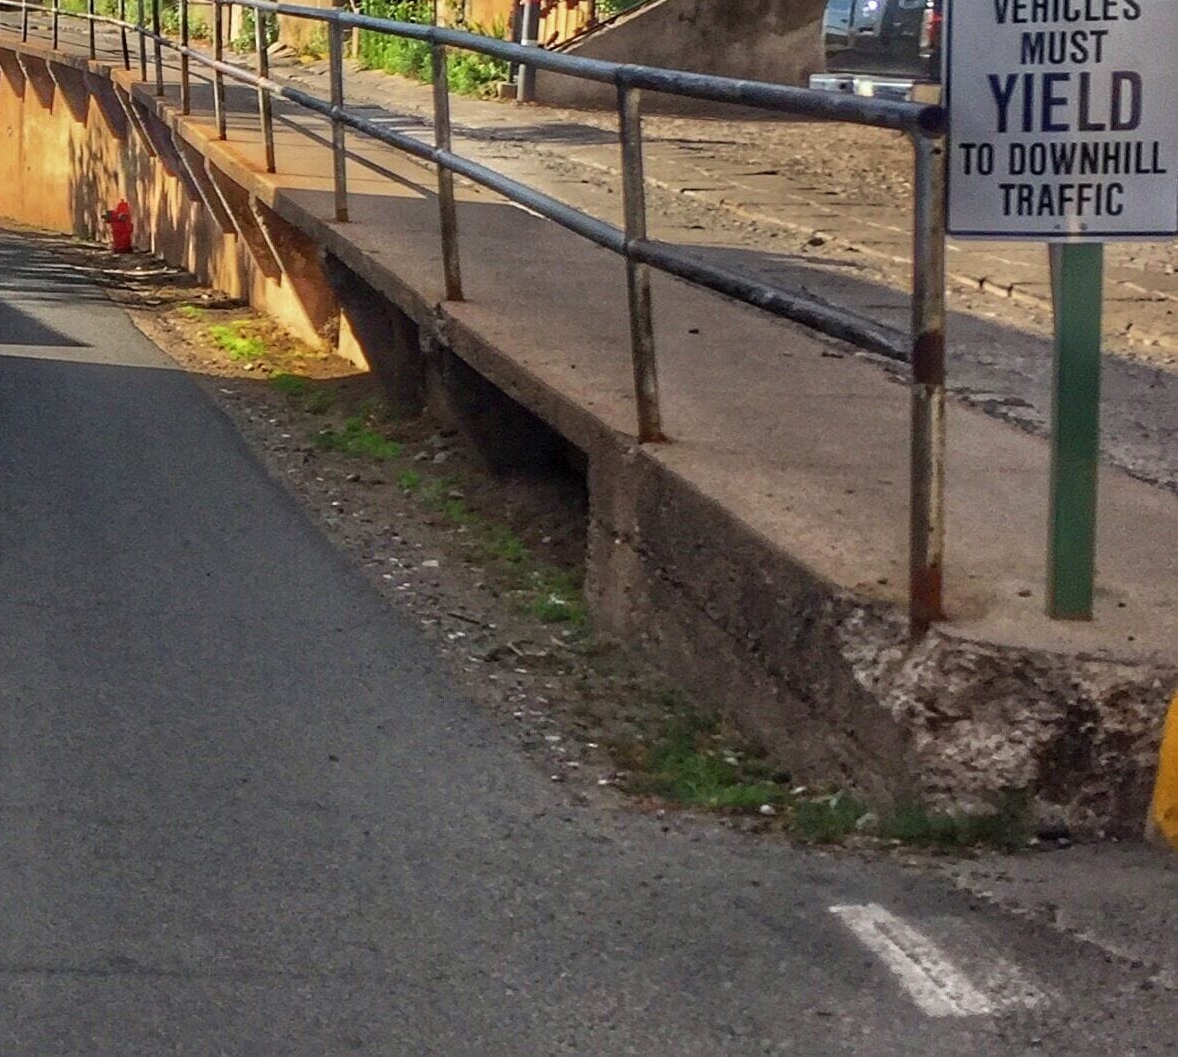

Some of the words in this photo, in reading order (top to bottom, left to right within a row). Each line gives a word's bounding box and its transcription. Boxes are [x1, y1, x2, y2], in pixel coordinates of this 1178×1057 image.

[1020, 29, 1109, 65] MUST
[986, 70, 1143, 133] YIELD
[959, 142, 994, 176] TO
[1009, 141, 1167, 175] DOWNHILL
[998, 182, 1124, 217] TRAFFIC
